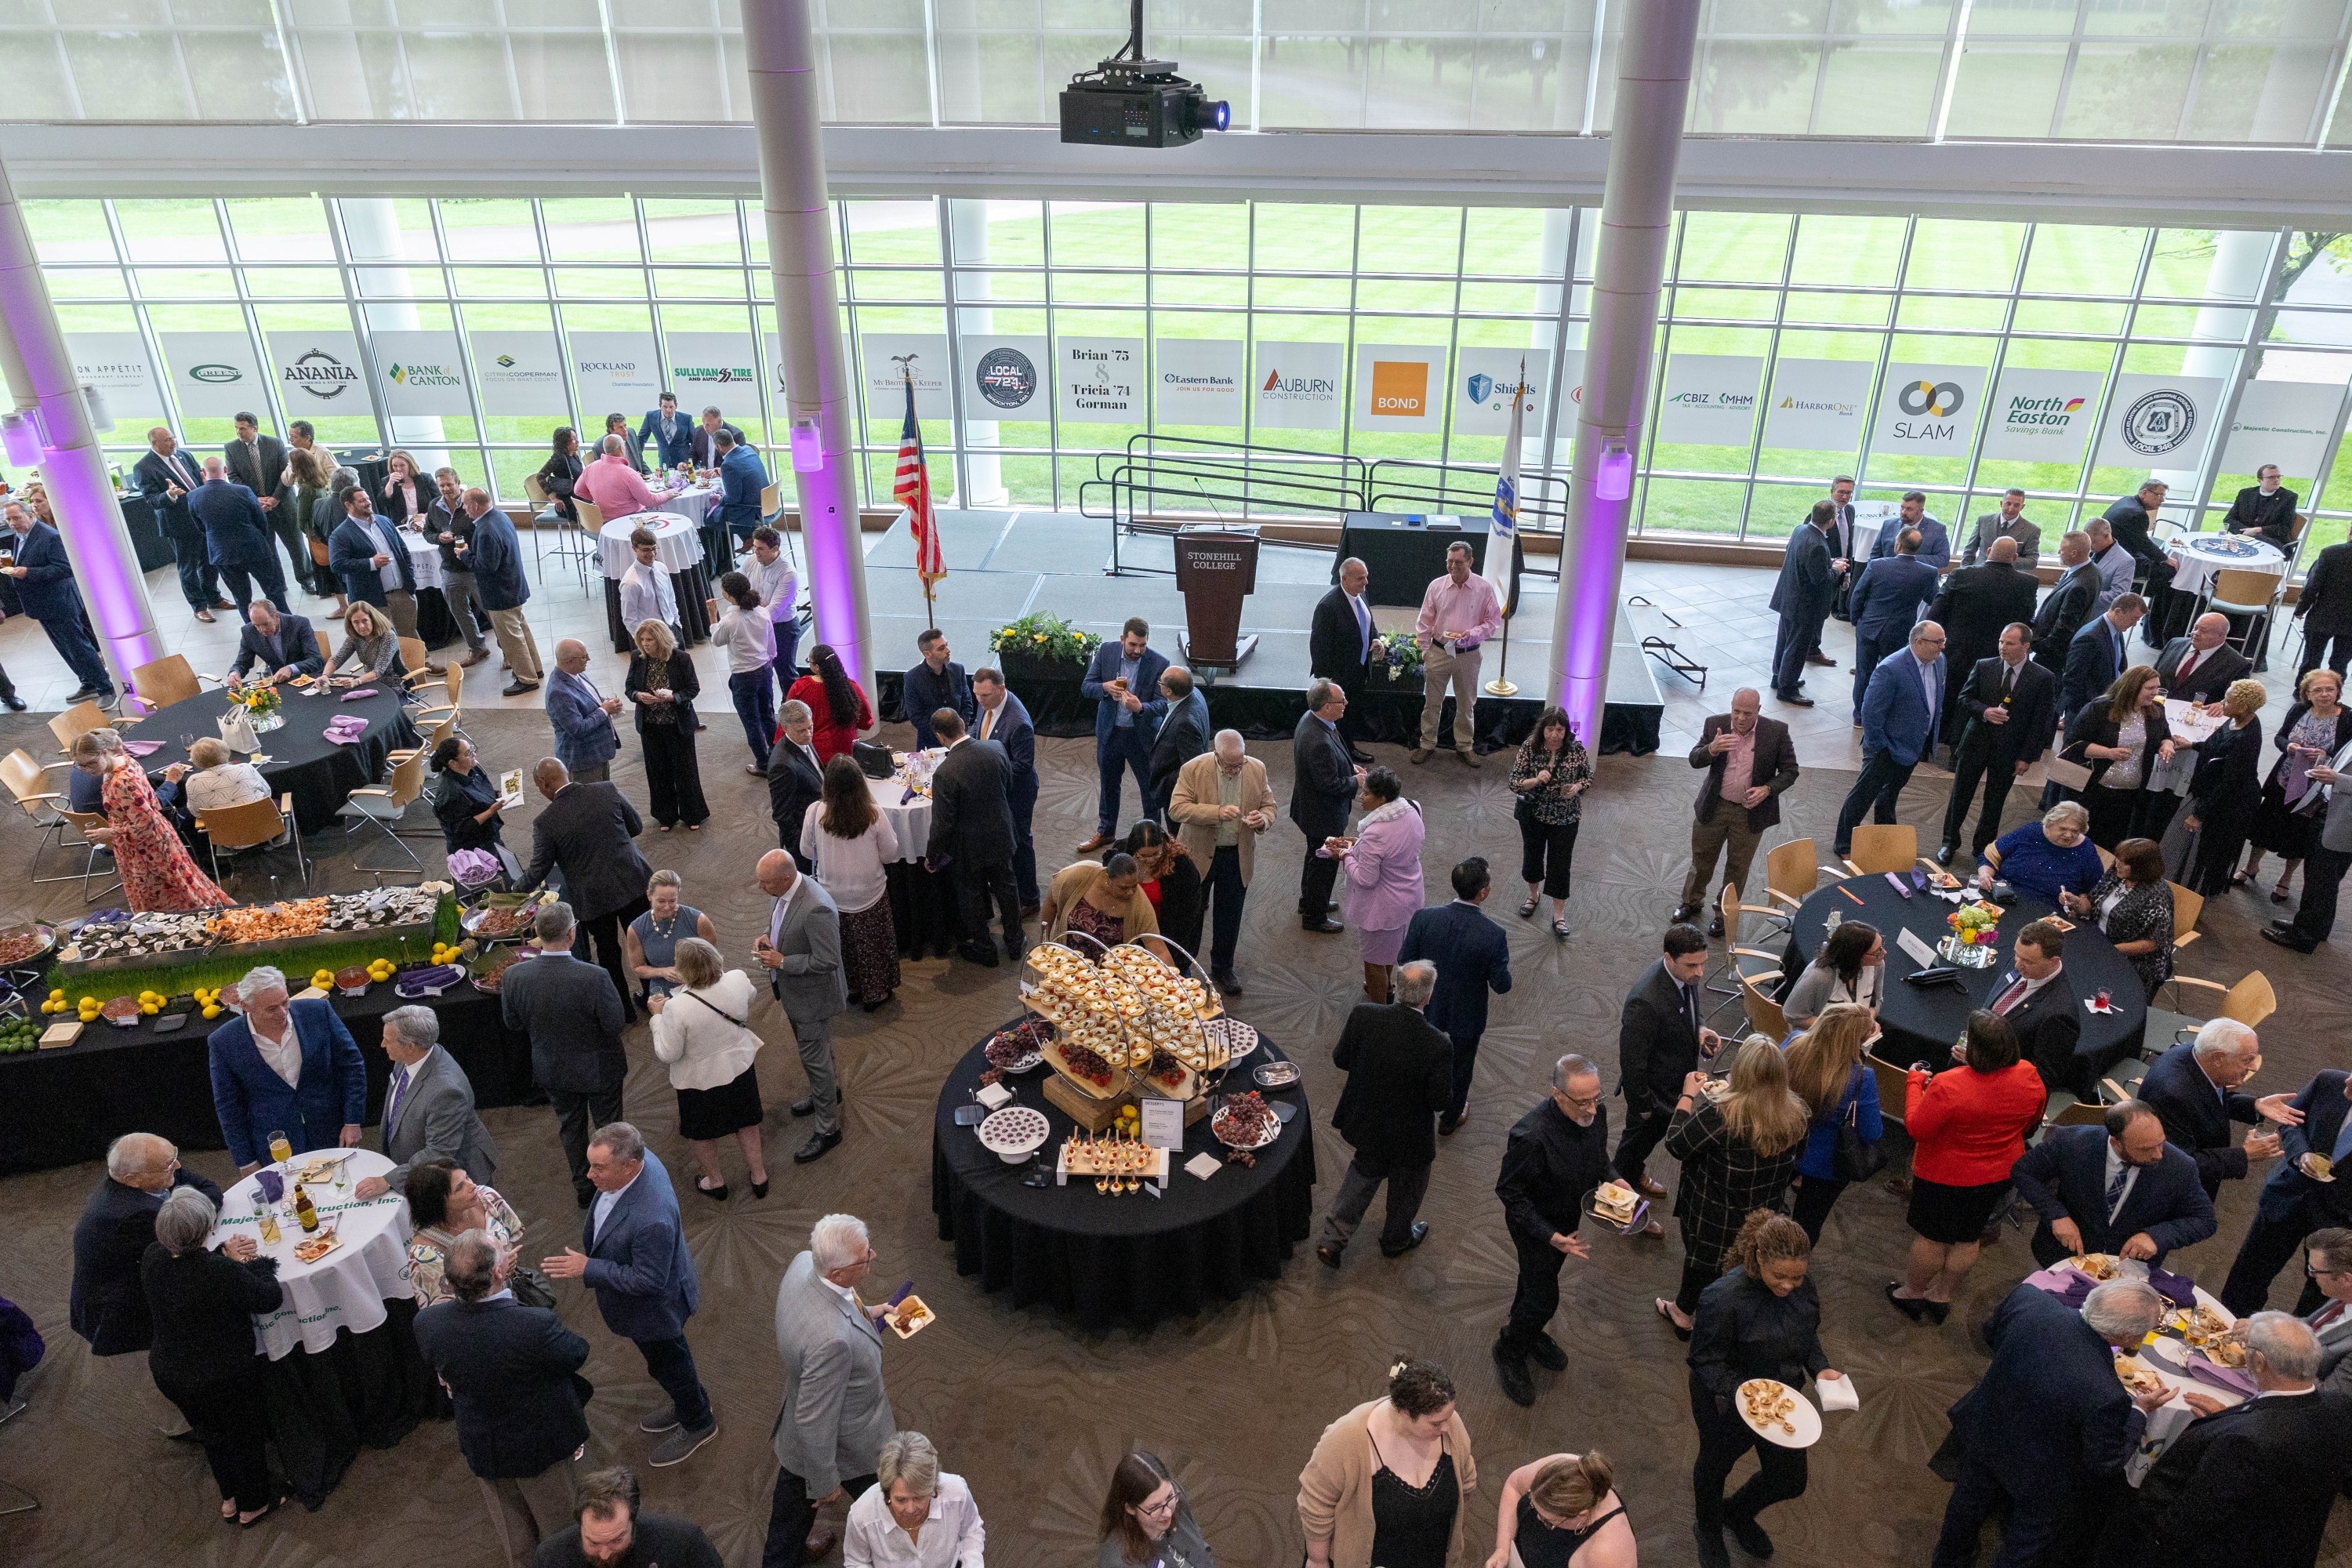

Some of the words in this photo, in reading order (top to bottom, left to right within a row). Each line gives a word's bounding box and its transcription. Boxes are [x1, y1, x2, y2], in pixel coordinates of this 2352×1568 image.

[1073, 349, 1108, 361] Brian
[1111, 350, 1130, 361] '75
[97, 363, 142, 372] APPÉTIT
[285, 366, 358, 379] ANANIA
[408, 365, 443, 375] BANK
[443, 365, 450, 376] of
[580, 362, 635, 372] ROCKLAND
[674, 368, 719, 376] SULLIVAN
[989, 365, 1022, 376] LOCAL
[1095, 363, 1109, 384] &
[410, 376, 460, 386] CANTON
[993, 376, 1018, 387] 721
[1273, 378, 1333, 393] AUBURN
[1071, 384, 1110, 396] Tricia
[1113, 385, 1131, 396] '74
[1494, 383, 1536, 395] Shieds
[987, 393, 1020, 406] BROCKTON,
[1262, 392, 1333, 401] CONSTRUCTION
[1683, 393, 1709, 403] CBIZ
[1076, 397, 1127, 409] Gorman
[1378, 397, 1418, 409] BOND
[2009, 396, 2063, 412] North
[2007, 410, 2071, 426] Easton
[1893, 422, 1955, 441] SLAM
[2005, 425, 2039, 435] Savings
[2132, 441, 2156, 452] LOCAL
[2157, 441, 2173, 452] 346
[1187, 552, 1242, 561] STONEHILL
[1192, 561, 1236, 570] COLLEGE
